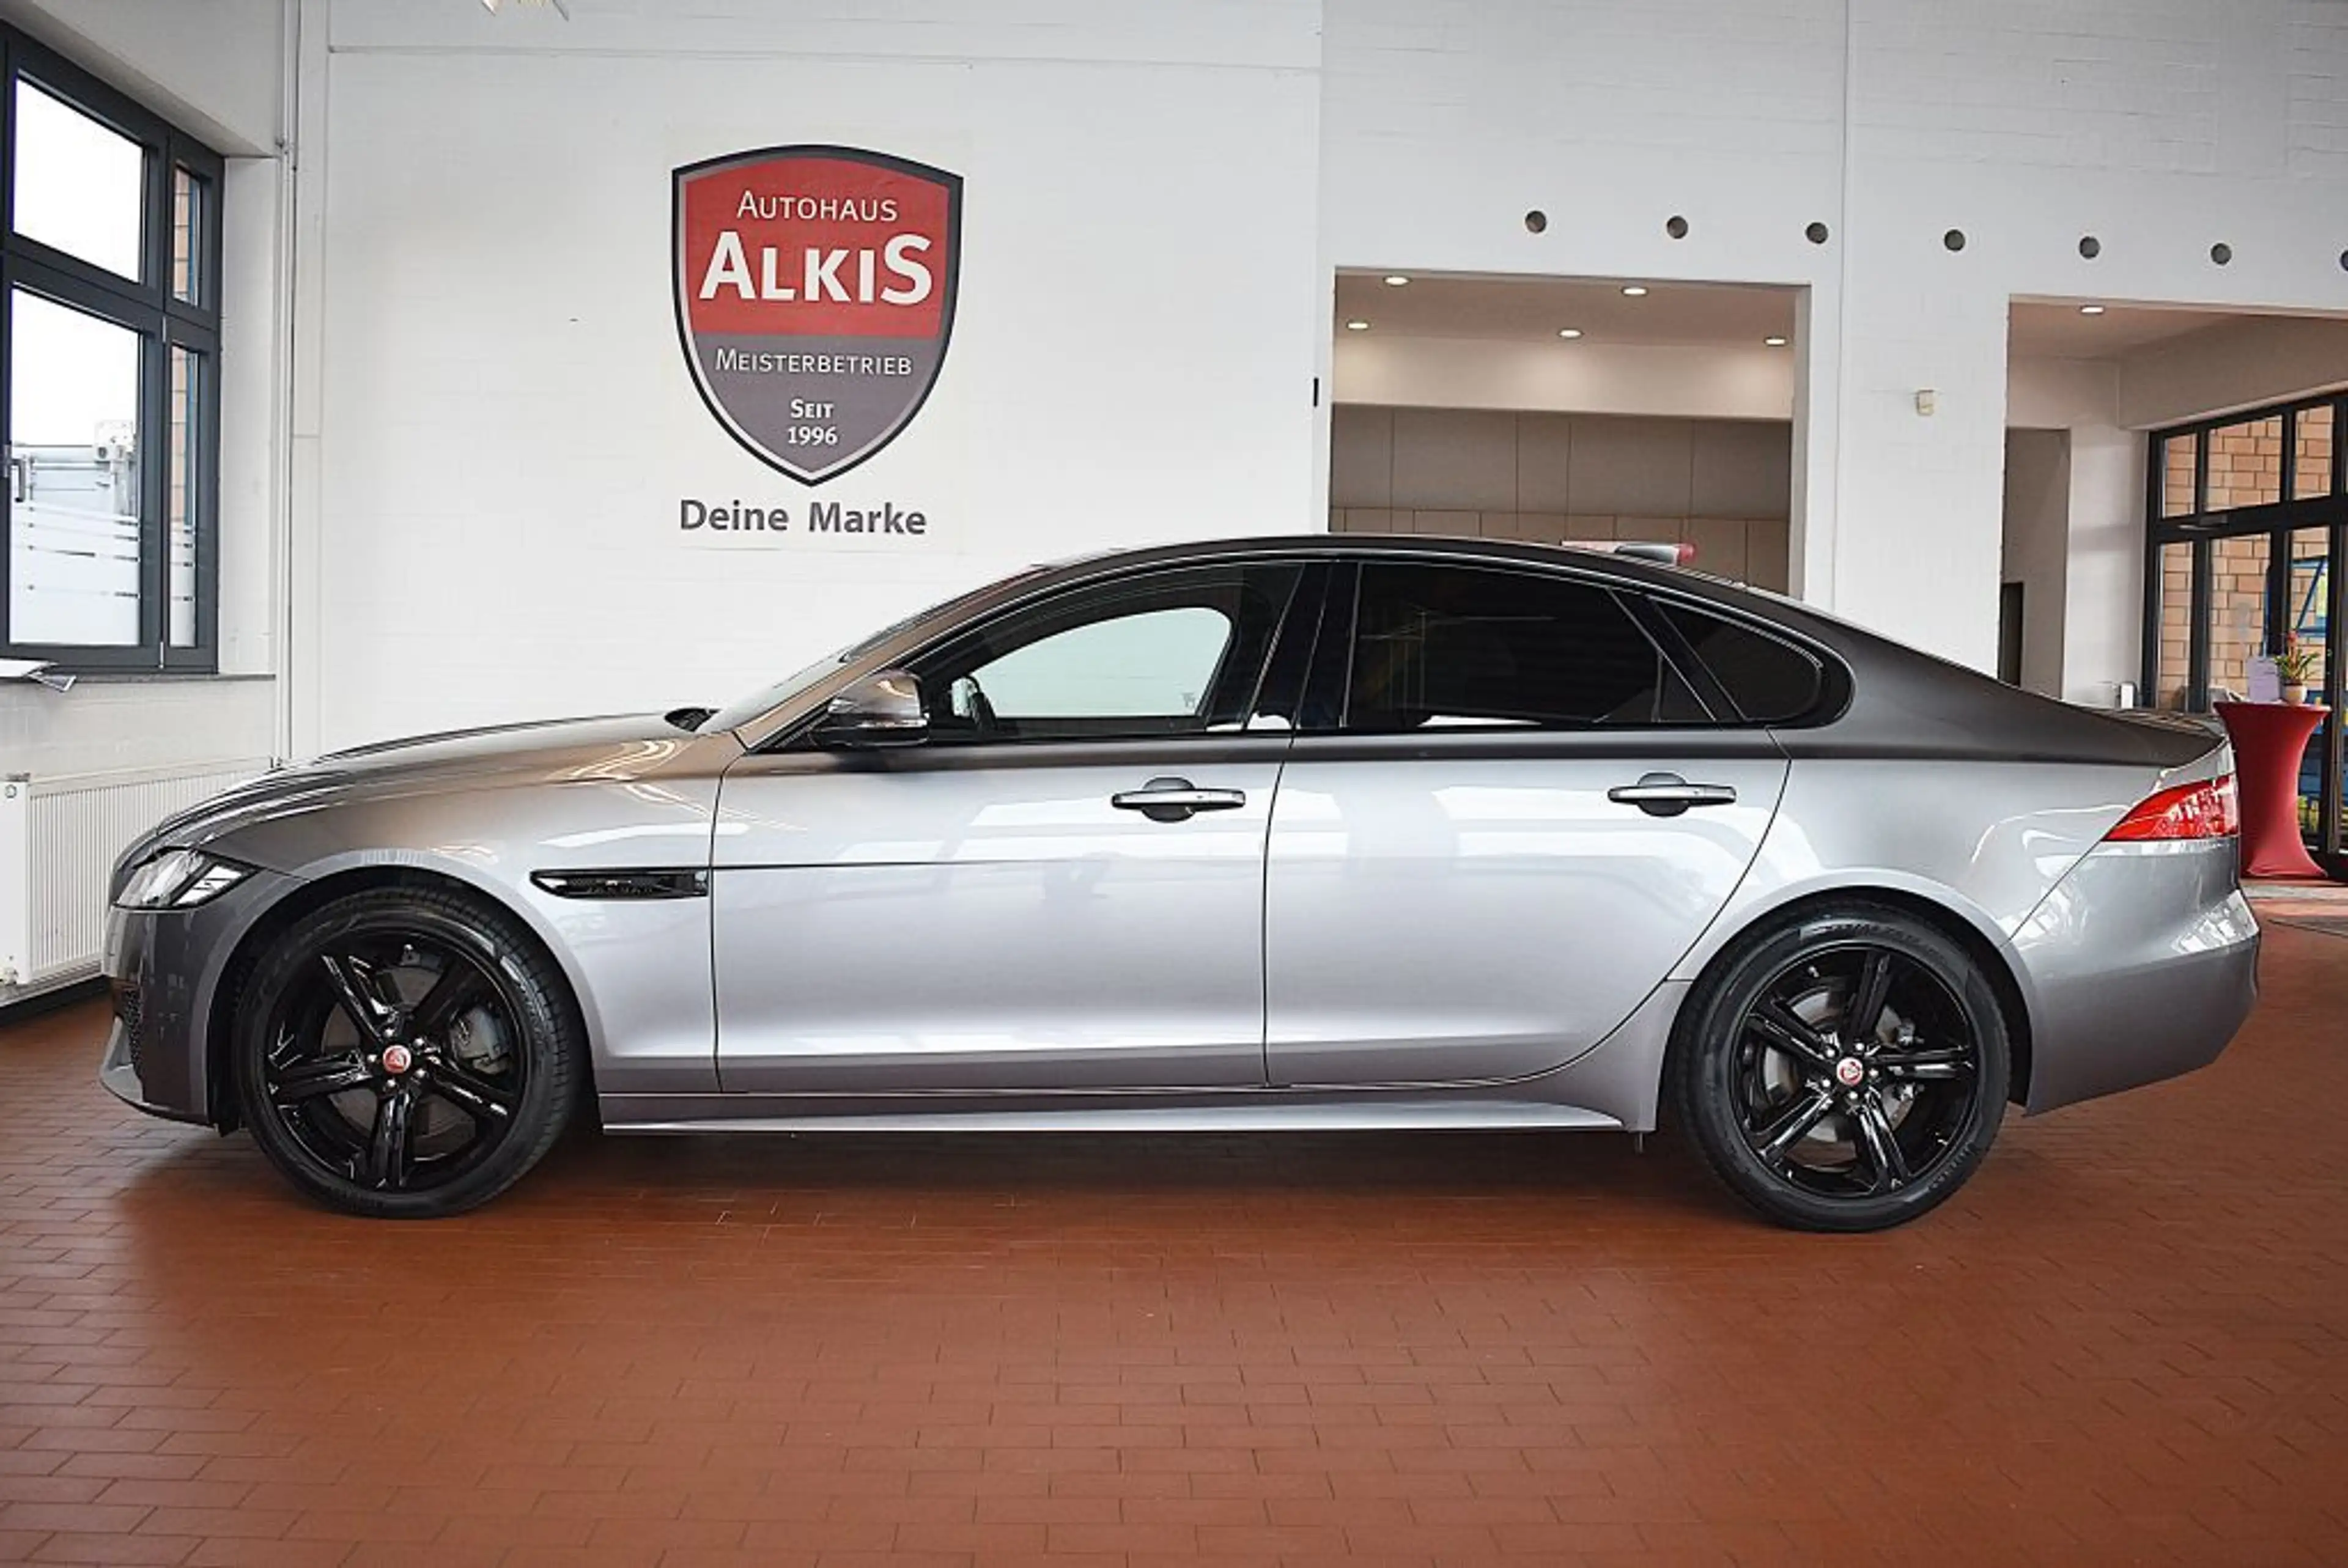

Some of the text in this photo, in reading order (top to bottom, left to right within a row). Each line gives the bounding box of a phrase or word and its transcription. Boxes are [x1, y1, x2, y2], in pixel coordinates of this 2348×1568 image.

[715, 347, 912, 376] MEISTERBETRIEB
[788, 425, 838, 446] 1996
[680, 498, 928, 535] Deine Marke
